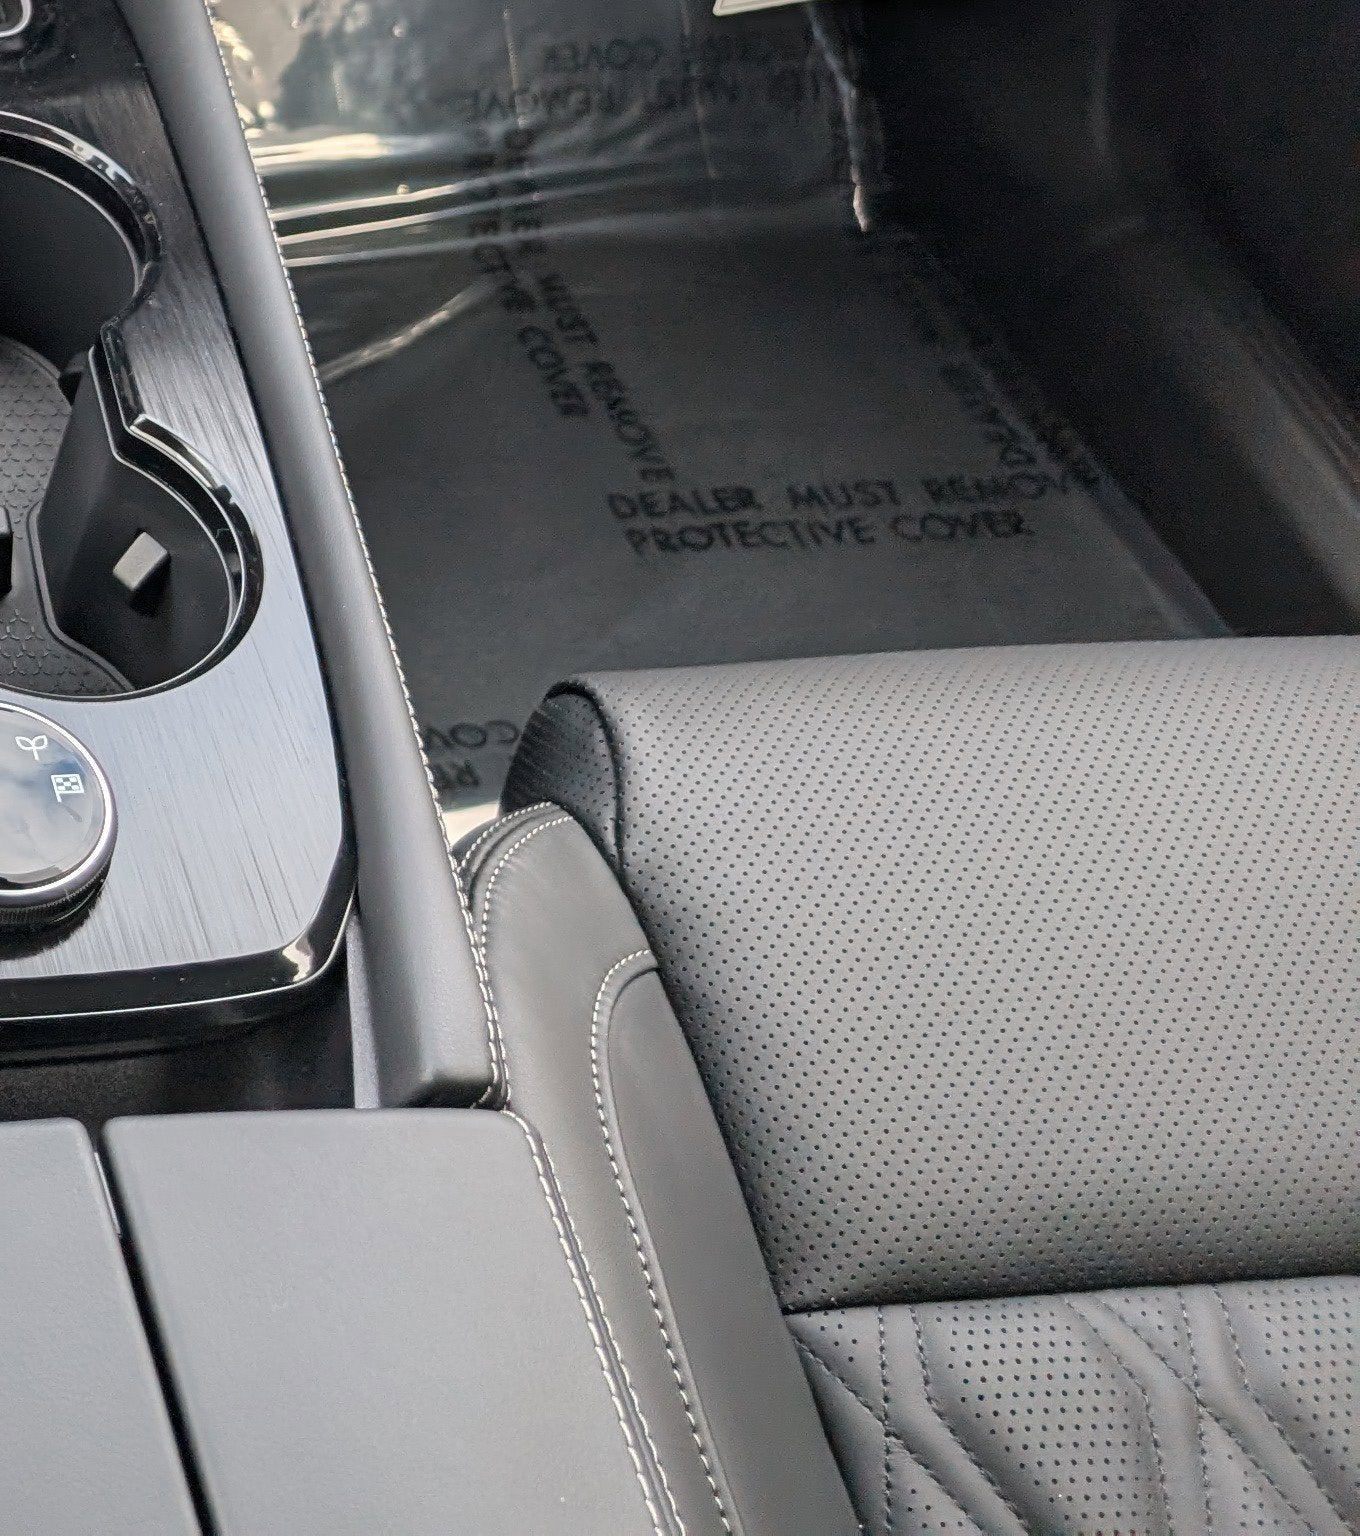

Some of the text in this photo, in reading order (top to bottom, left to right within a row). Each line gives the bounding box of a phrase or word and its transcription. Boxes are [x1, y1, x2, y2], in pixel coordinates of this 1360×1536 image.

[606, 486, 761, 524] DEALER
[786, 477, 904, 511] MUST
[624, 508, 1034, 557] PROTECTIVE COVER
